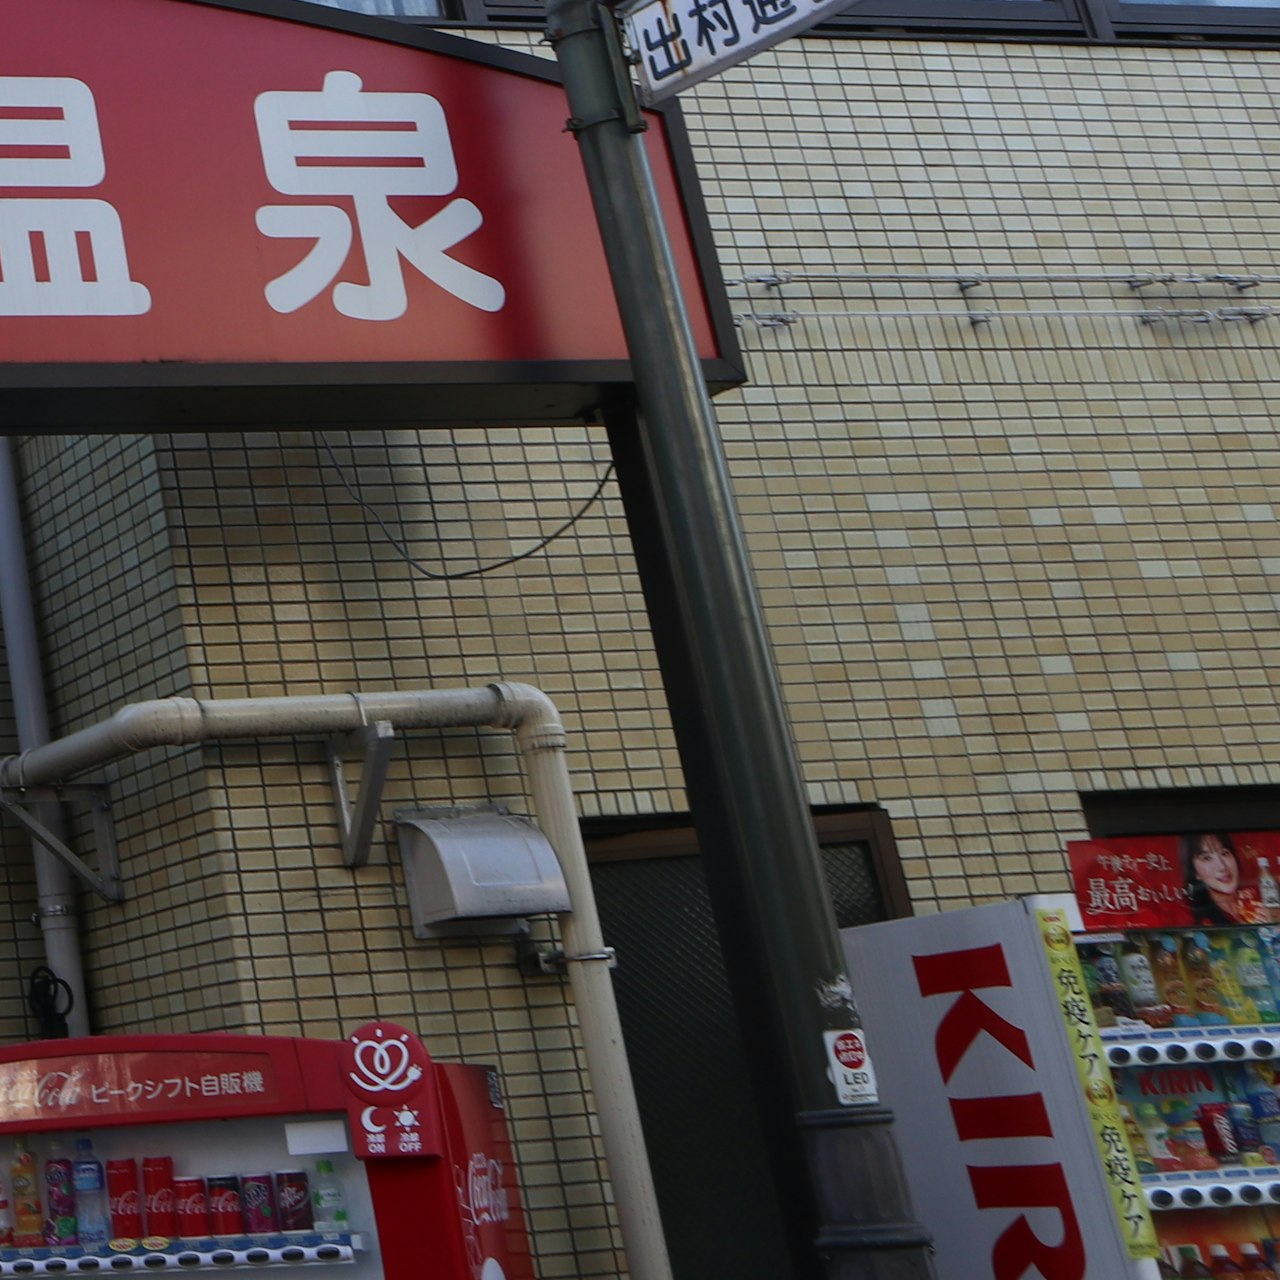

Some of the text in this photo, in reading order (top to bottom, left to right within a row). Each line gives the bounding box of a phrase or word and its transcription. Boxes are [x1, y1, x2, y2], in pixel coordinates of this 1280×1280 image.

[1057, 968, 1100, 1076] 免疫ケア
[91, 1070, 265, 1104] ピークシフト自販機
[843, 1072, 870, 1085] LED
[1138, 1070, 1216, 1095] KIRIN
[368, 1143, 386, 1154] ON
[399, 1142, 422, 1153] OFF
[1100, 1125, 1144, 1237] 免疫ケア
